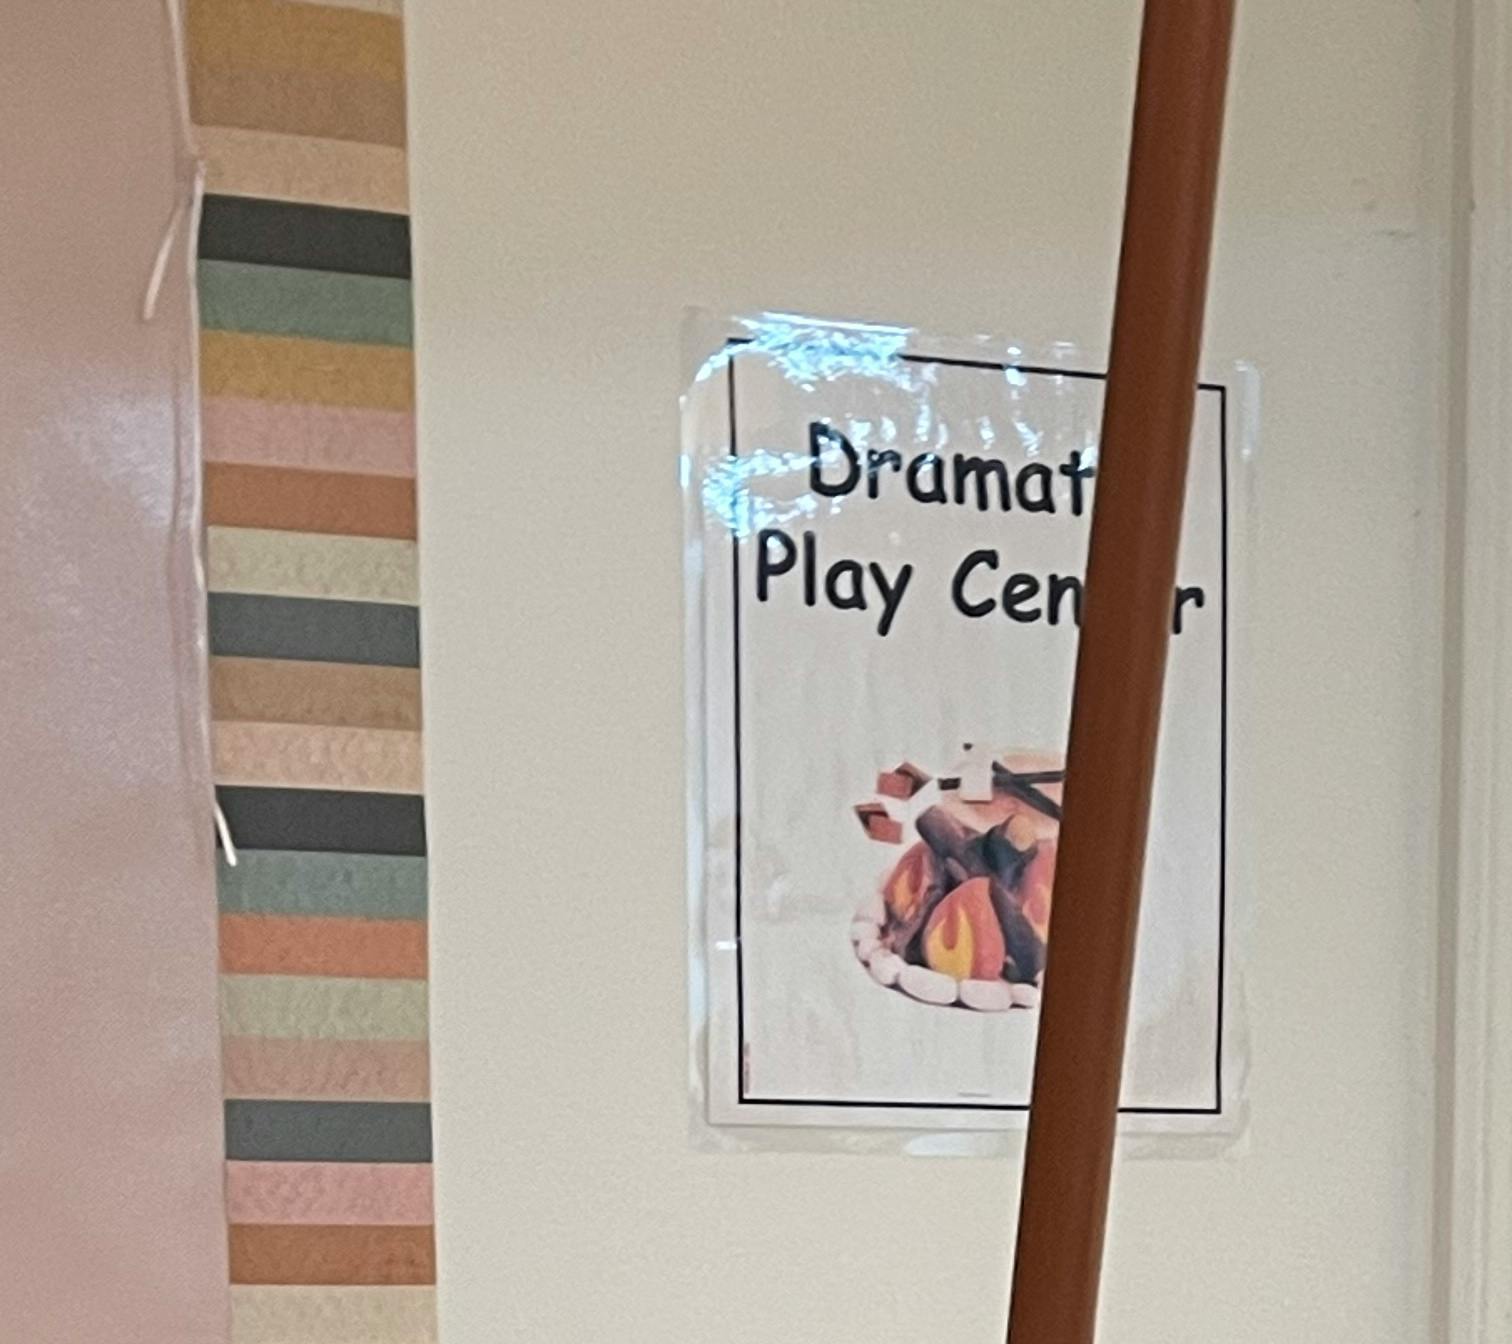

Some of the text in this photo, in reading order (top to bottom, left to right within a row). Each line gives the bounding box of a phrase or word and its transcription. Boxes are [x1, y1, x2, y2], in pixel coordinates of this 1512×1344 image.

[810, 421, 1096, 517] Dramat
[756, 528, 1205, 637] Play Cenr
